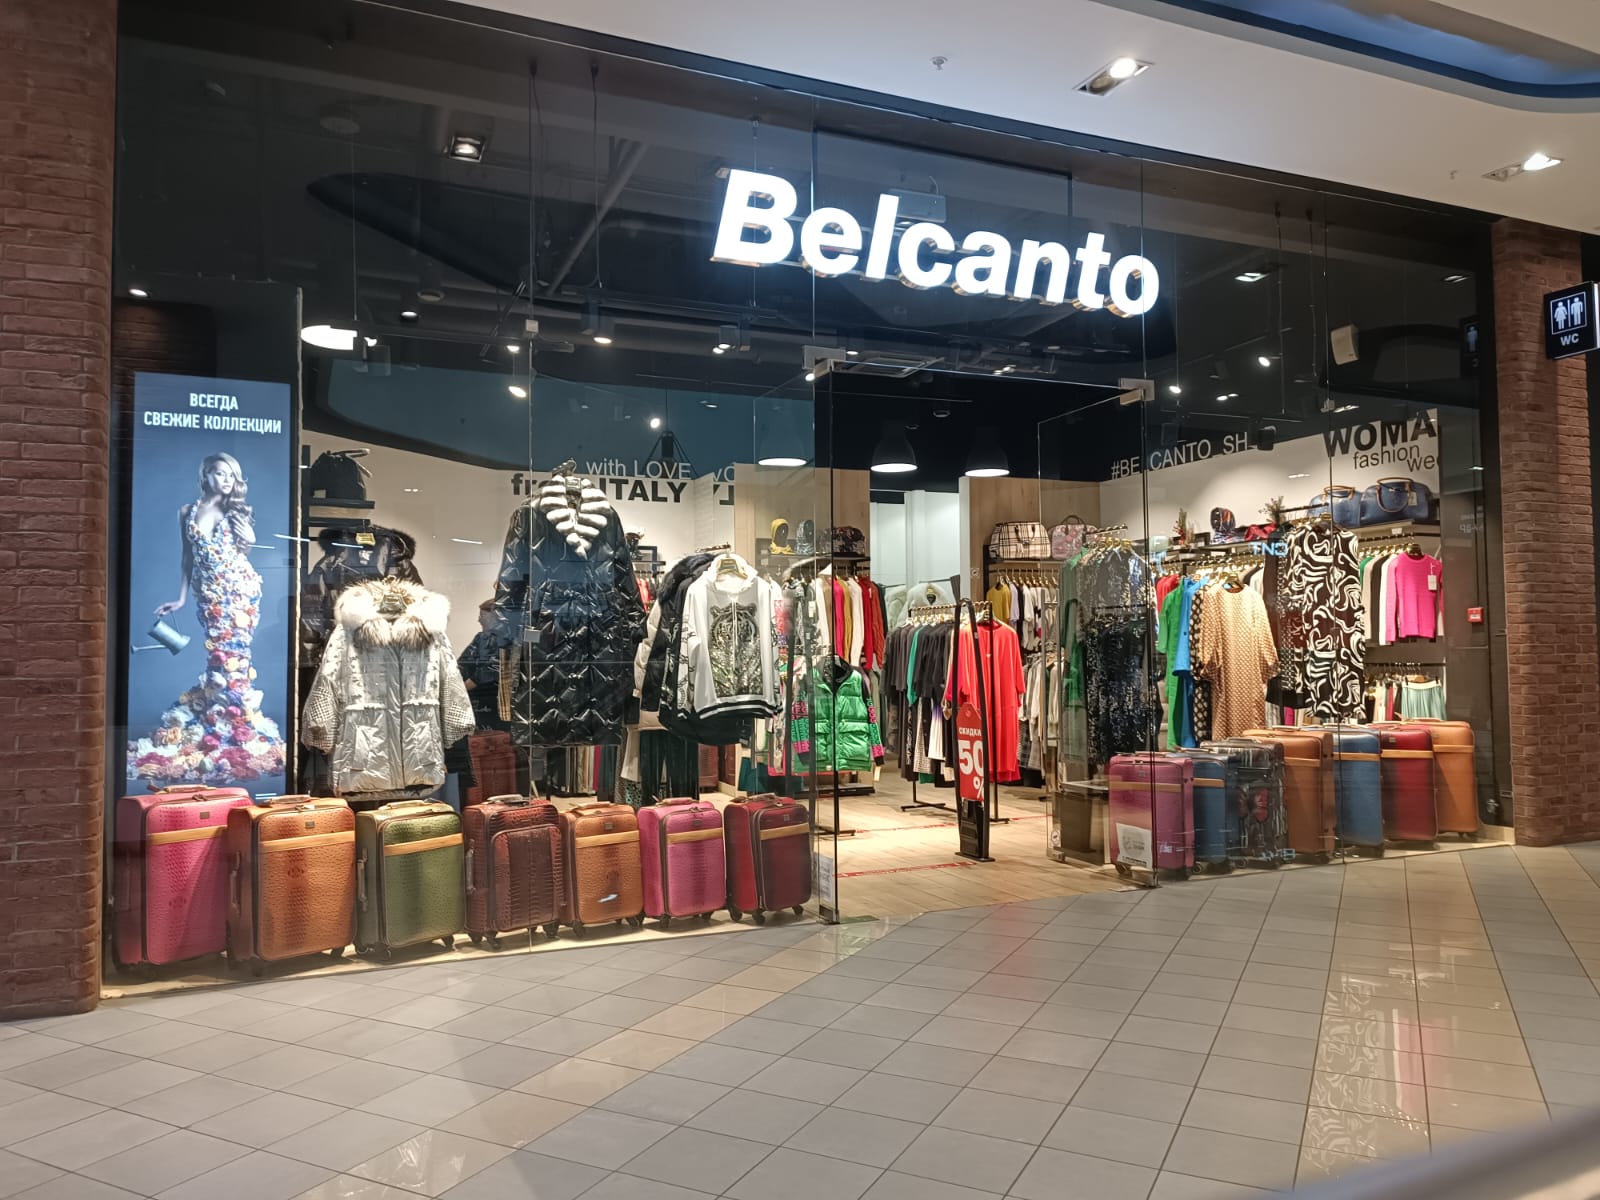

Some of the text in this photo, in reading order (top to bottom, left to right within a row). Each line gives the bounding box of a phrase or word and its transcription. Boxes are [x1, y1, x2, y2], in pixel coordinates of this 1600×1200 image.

[712, 169, 1160, 317] Belcanto
[1560, 333, 1580, 346] WC
[189, 393, 239, 412] ВСЕГДА
[143, 411, 282, 434] СВЕЖИЕ КОЛЛЕКЦИИ
[1323, 409, 1440, 457] WOMA
[586, 458, 626, 477] with
[634, 460, 691, 480] LOVE
[1353, 444, 1420, 469] fashion
[599, 478, 687, 503] ITALY
[958, 739, 984, 777] 50
